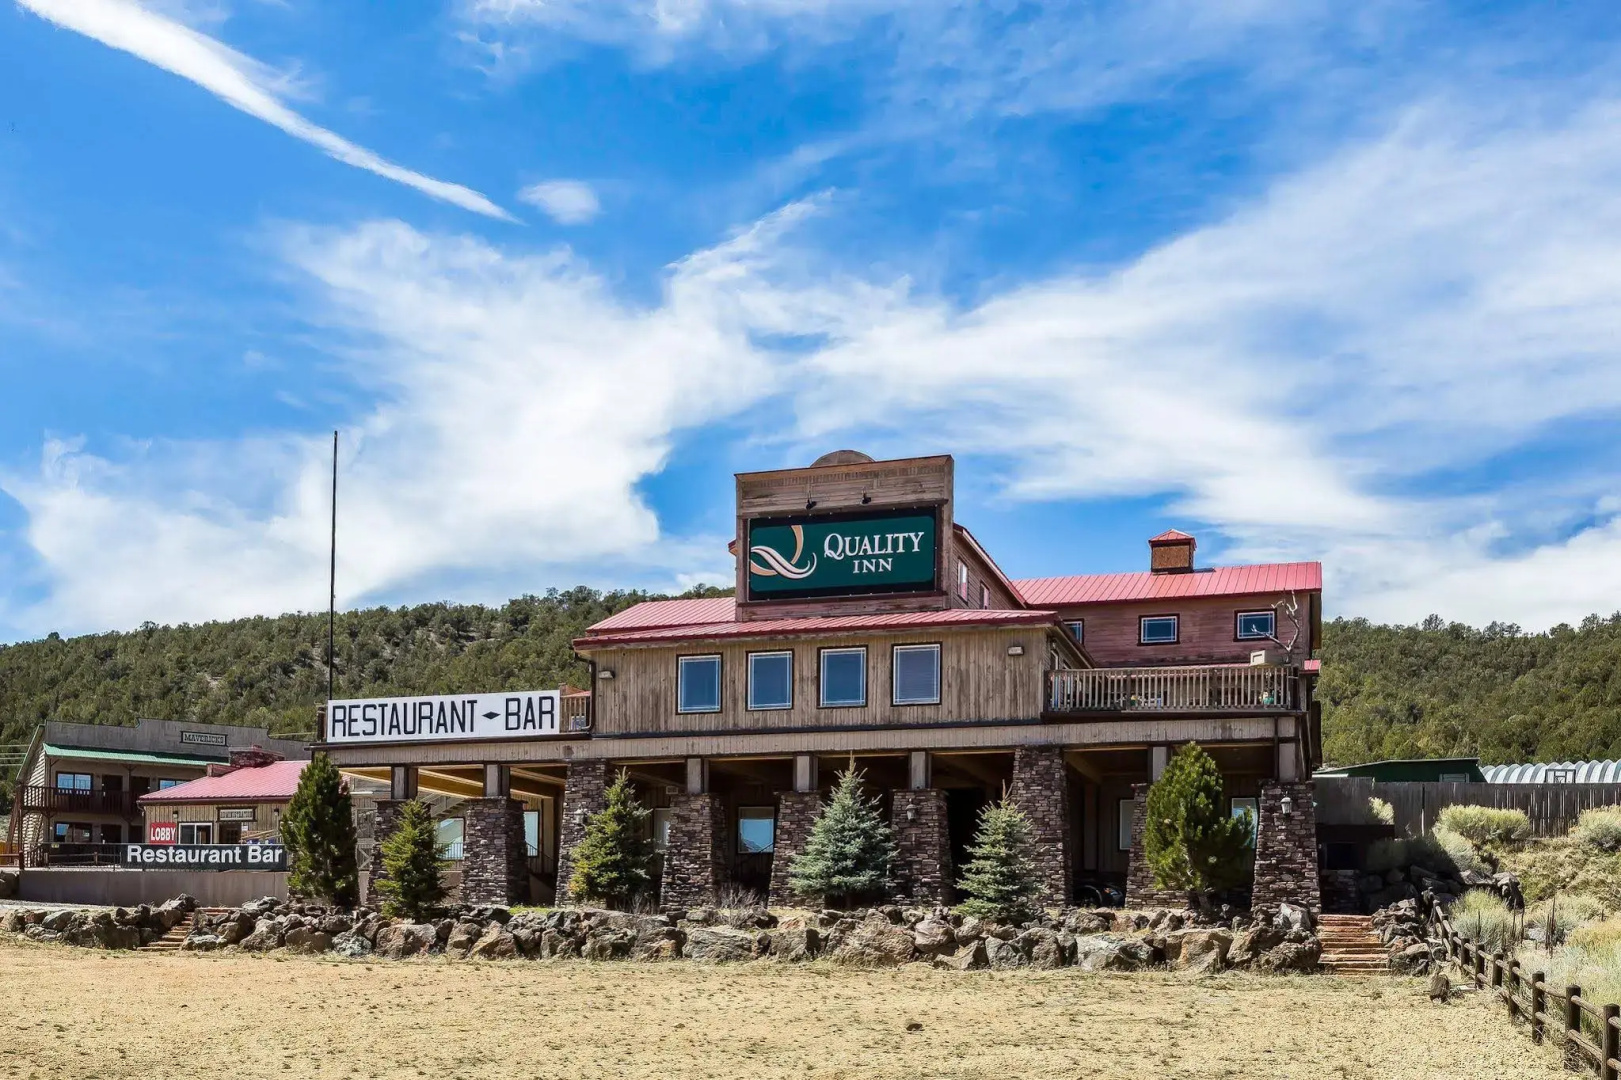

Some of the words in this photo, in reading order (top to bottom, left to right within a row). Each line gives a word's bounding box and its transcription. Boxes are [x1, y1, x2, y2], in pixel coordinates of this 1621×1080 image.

[824, 532, 925, 561] QUALITY
[852, 558, 893, 574] INN
[331, 700, 478, 738] RESTAURANT
[505, 696, 555, 731] BAR
[150, 827, 176, 841] LOBBY
[127, 845, 242, 863] Restaurant
[247, 845, 283, 863] Bar
